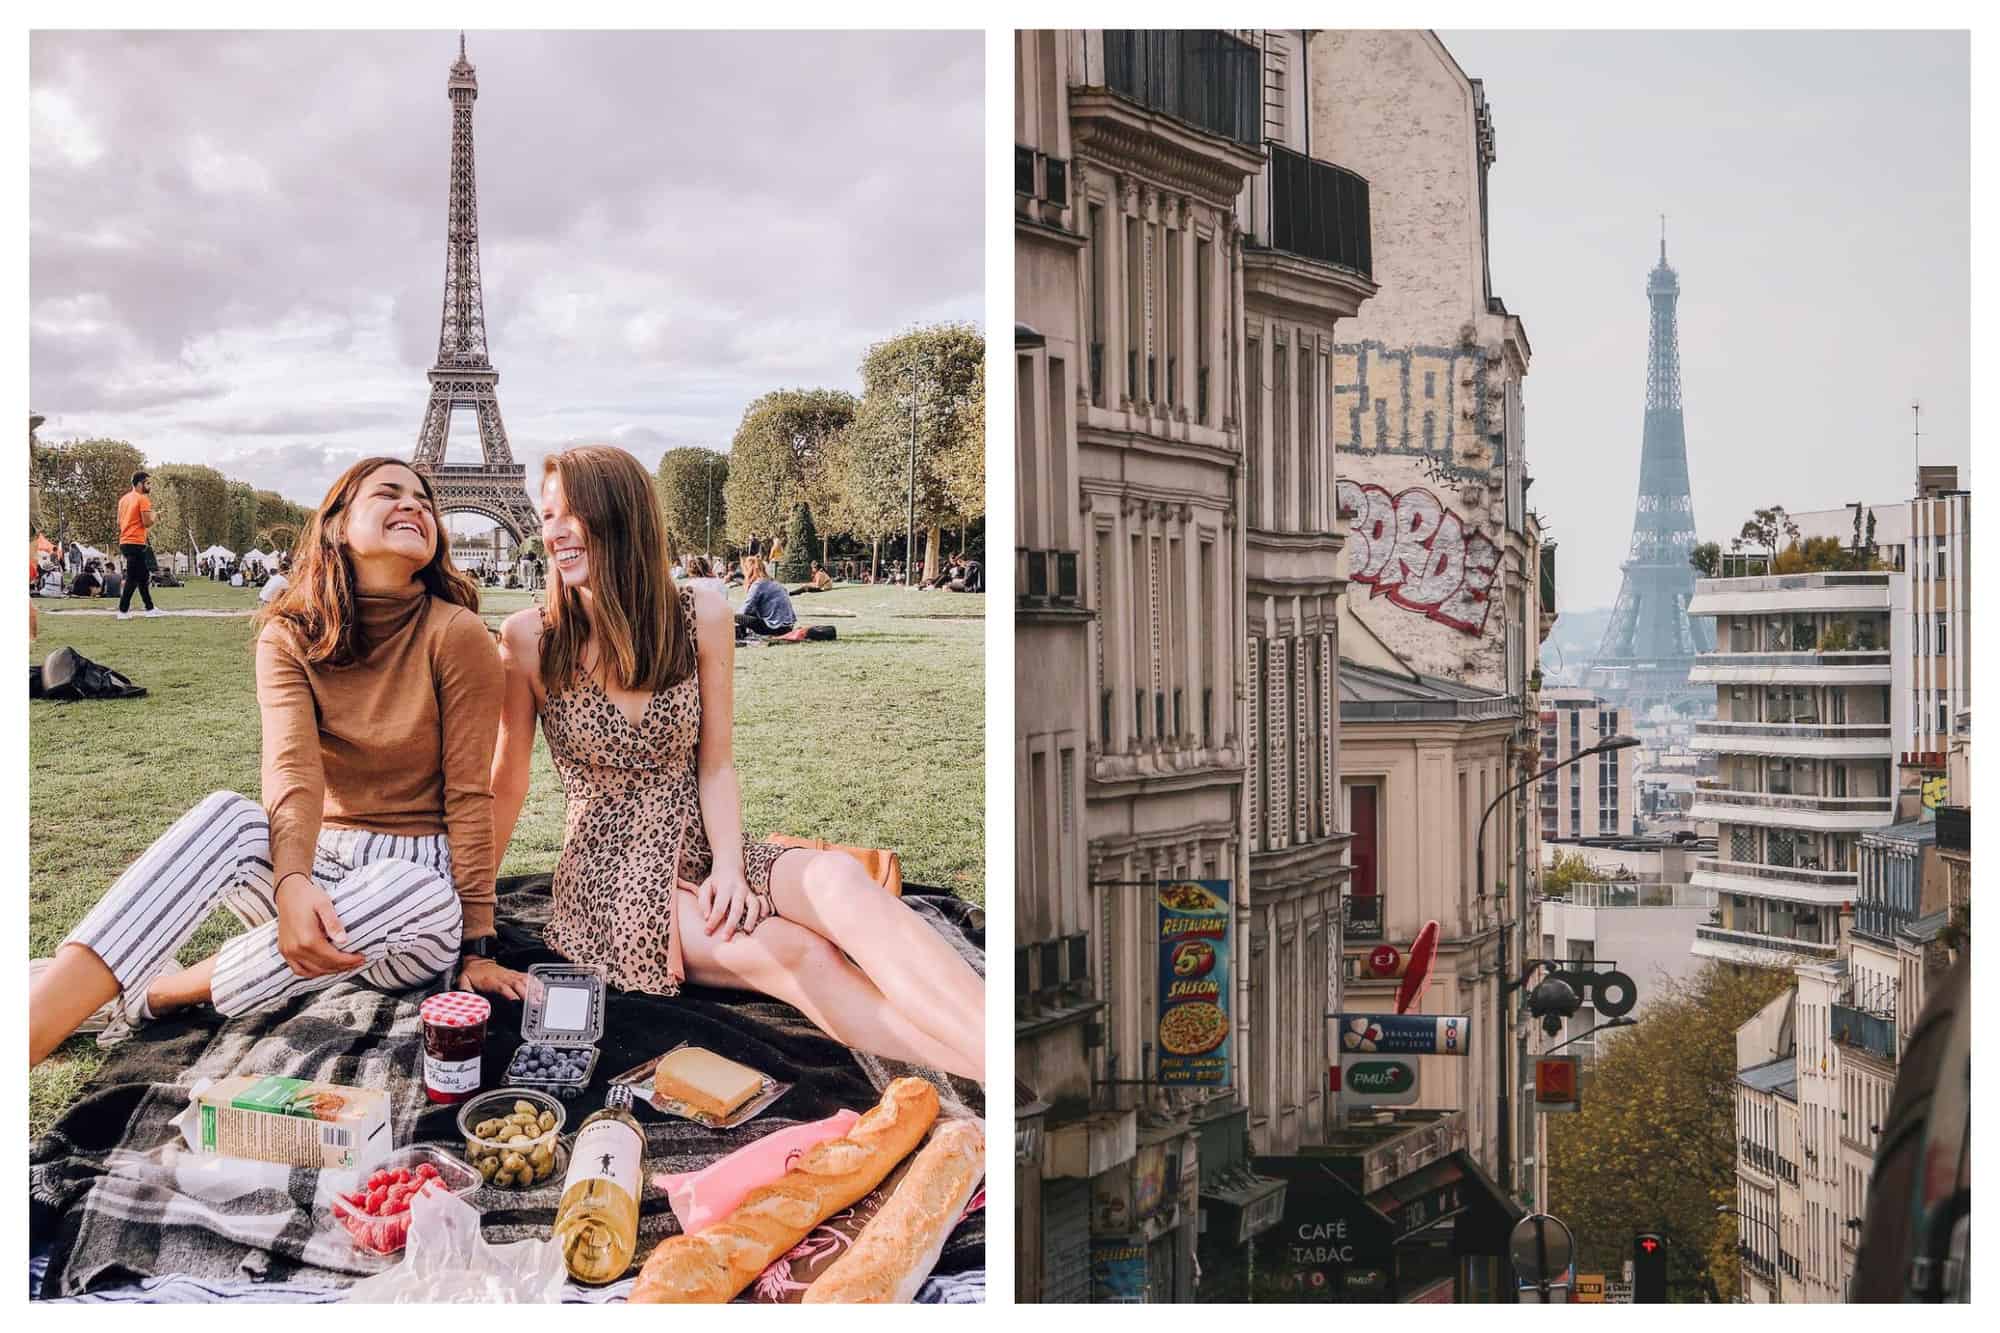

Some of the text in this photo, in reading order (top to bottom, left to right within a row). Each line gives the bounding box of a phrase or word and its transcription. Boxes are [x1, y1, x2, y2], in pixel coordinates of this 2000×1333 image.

[1162, 918, 1227, 935] RESTAURANT
[1168, 981, 1218, 997] SAISON
[1353, 1073, 1385, 1084] PMU
[1298, 1218, 1347, 1240] CAFÉ
[1293, 1246, 1353, 1263] TABAC
